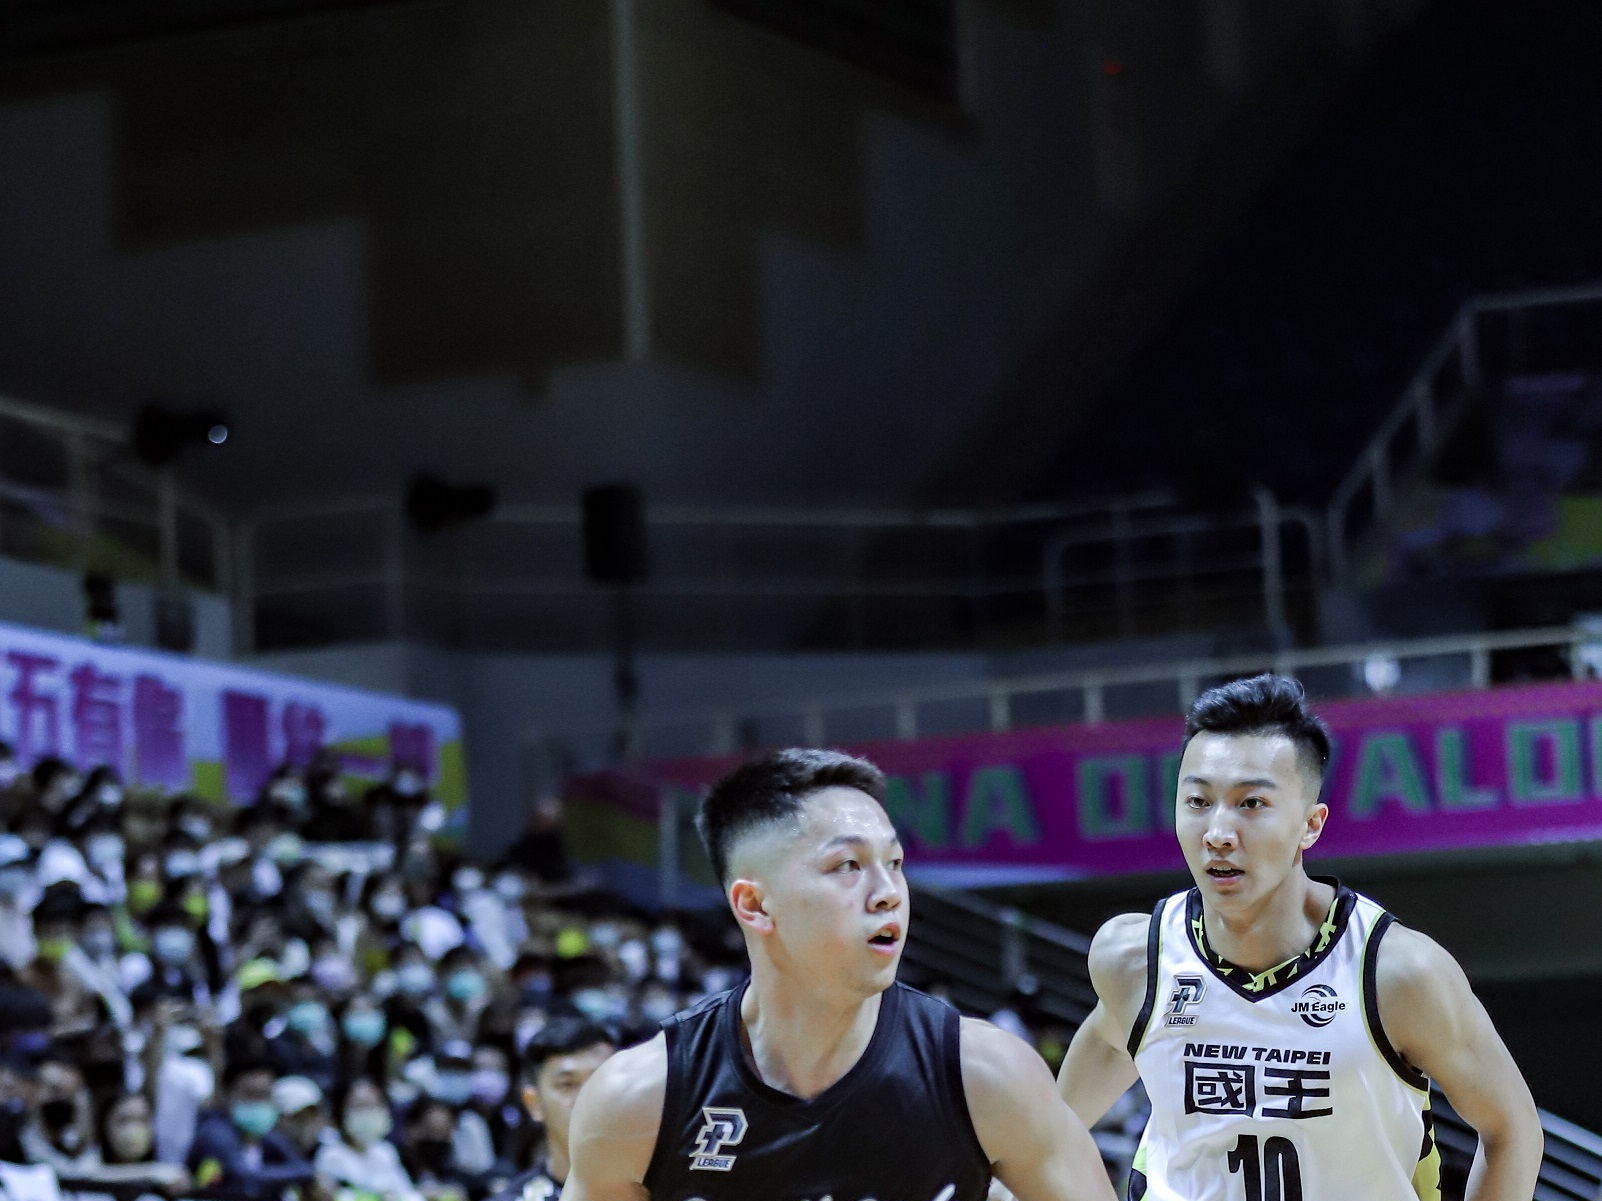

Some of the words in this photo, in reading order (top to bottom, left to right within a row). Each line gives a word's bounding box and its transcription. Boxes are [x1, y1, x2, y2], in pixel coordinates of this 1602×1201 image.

[1350, 714, 1602, 818] ALO
[1291, 1002, 1309, 1013] JM
[1312, 1000, 1346, 1013] Eagle
[1168, 1016, 1196, 1025] LEAGUE
[1184, 1043, 1248, 1060] NEW
[1251, 1047, 1331, 1065] TAIPEI
[1184, 1060, 1333, 1119] 國王
[697, 1158, 731, 1169] LEAGUE
